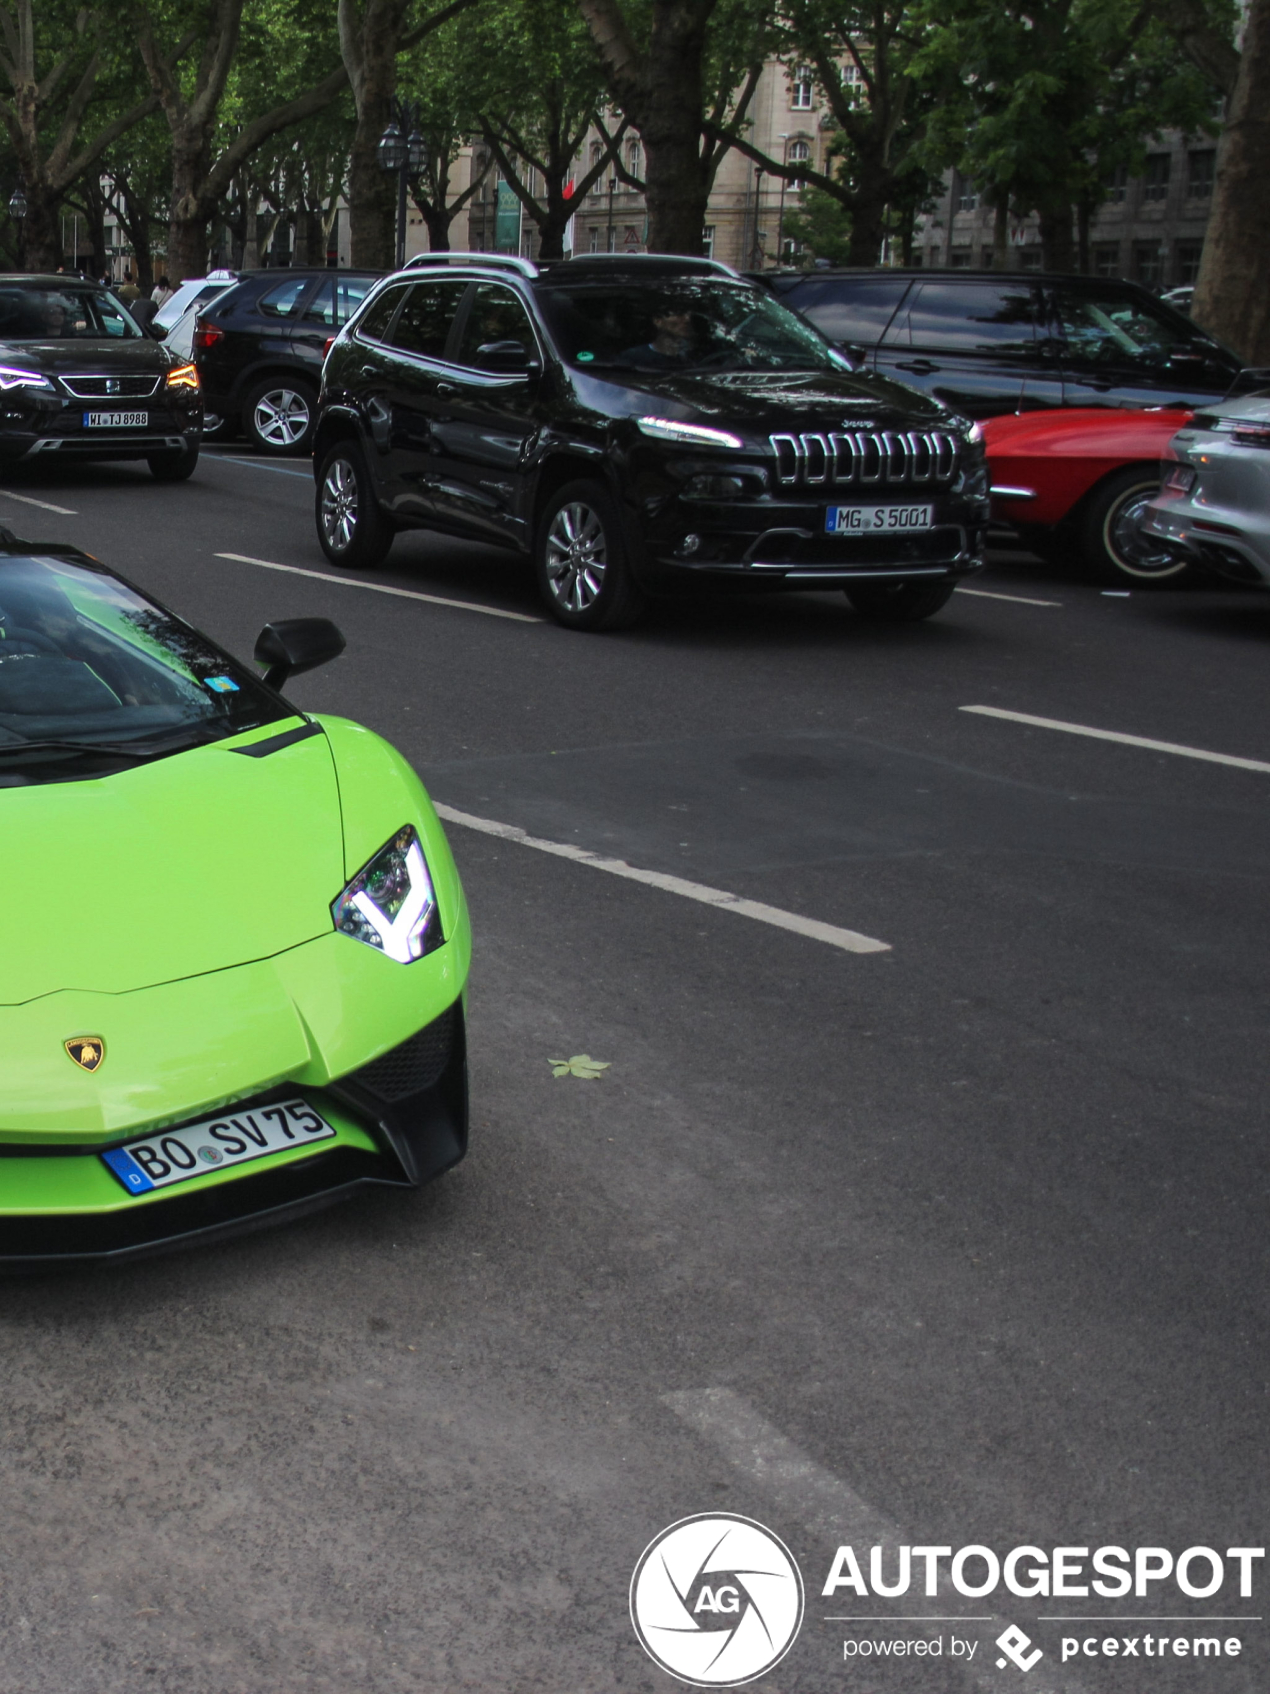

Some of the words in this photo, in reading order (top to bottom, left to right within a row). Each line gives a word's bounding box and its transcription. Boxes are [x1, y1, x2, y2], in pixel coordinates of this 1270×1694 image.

[90, 413, 101, 425] WI
[109, 413, 121, 425] TJ
[123, 413, 147, 425] 8988
[837, 509, 862, 529] MG
[873, 509, 885, 528] S
[888, 507, 929, 527] 5001
[129, 1136, 197, 1180] BO
[208, 1114, 269, 1155] SV
[261, 1102, 324, 1140] 75
